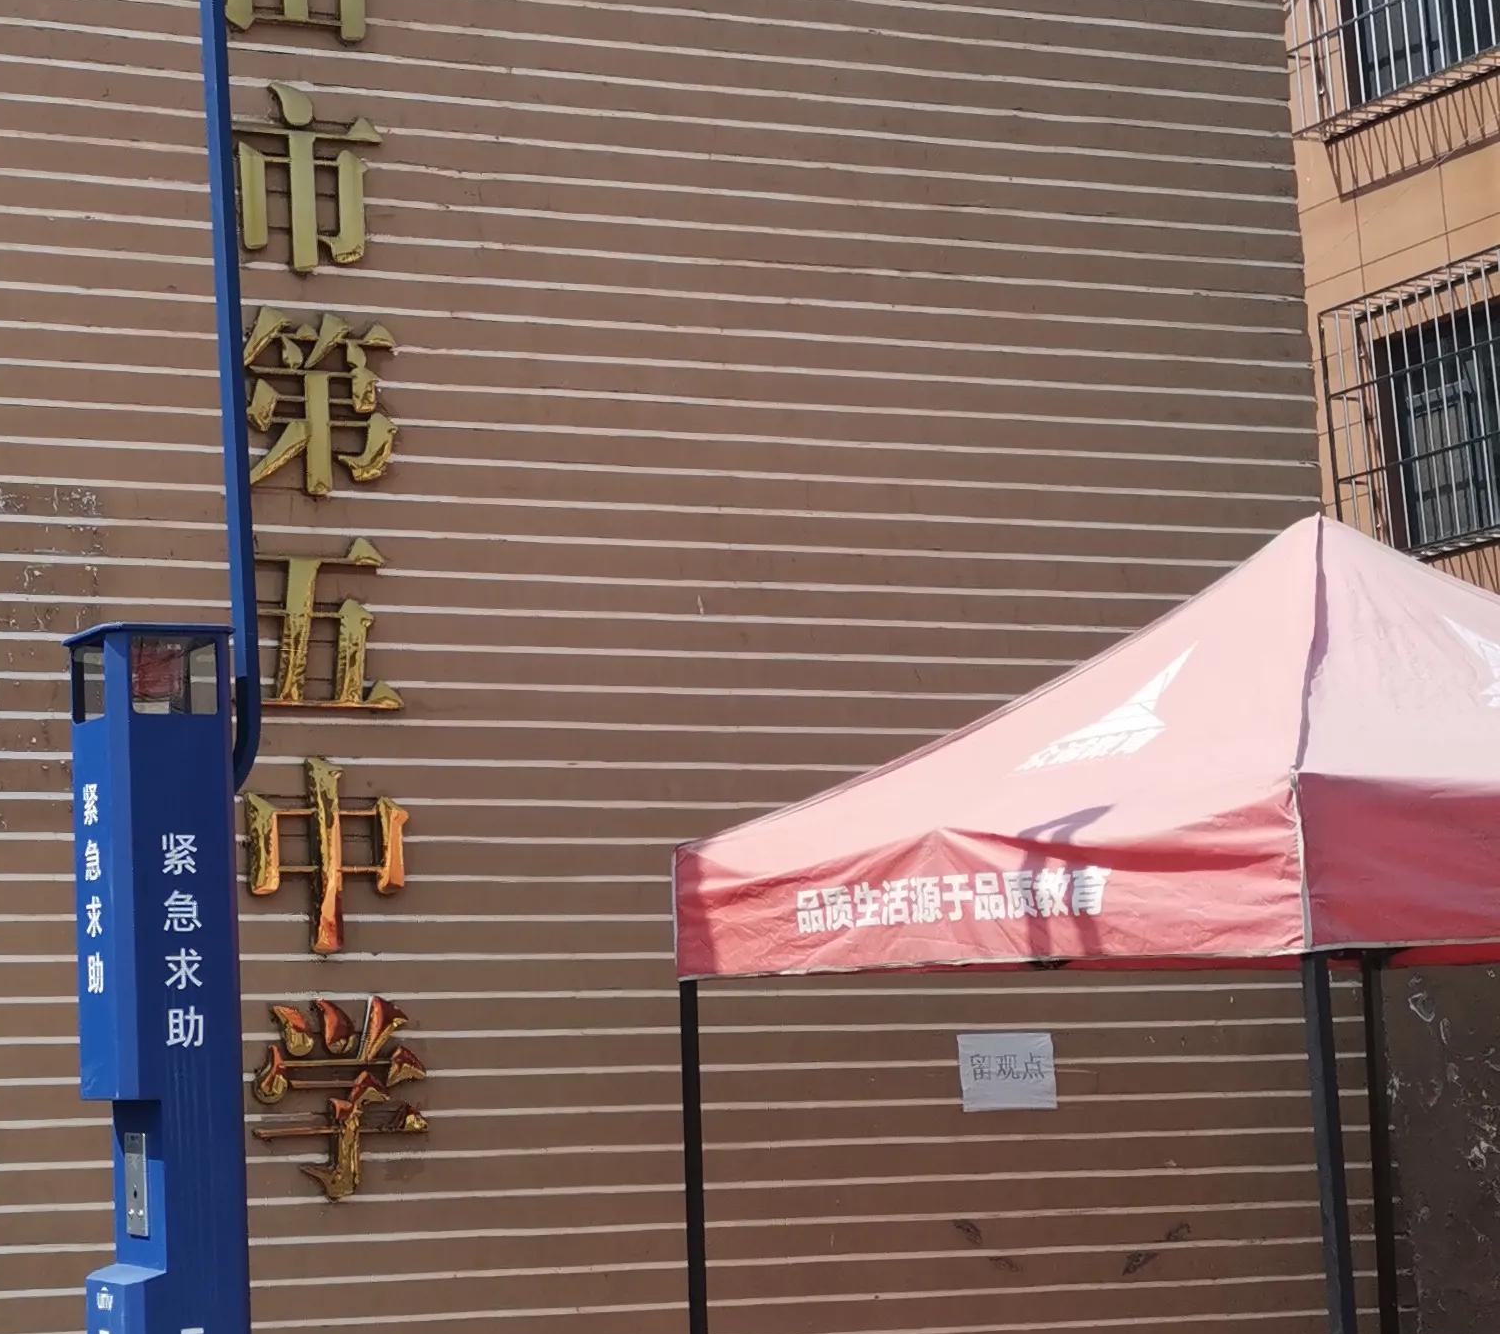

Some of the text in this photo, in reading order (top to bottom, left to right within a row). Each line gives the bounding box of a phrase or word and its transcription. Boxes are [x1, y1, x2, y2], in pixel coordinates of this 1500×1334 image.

[82, 783, 105, 994] 紧急求助
[160, 832, 206, 1049] 紧急求助
[796, 865, 1112, 934] 品质生活源于品质教育
[969, 1051, 1047, 1082] 留观点
